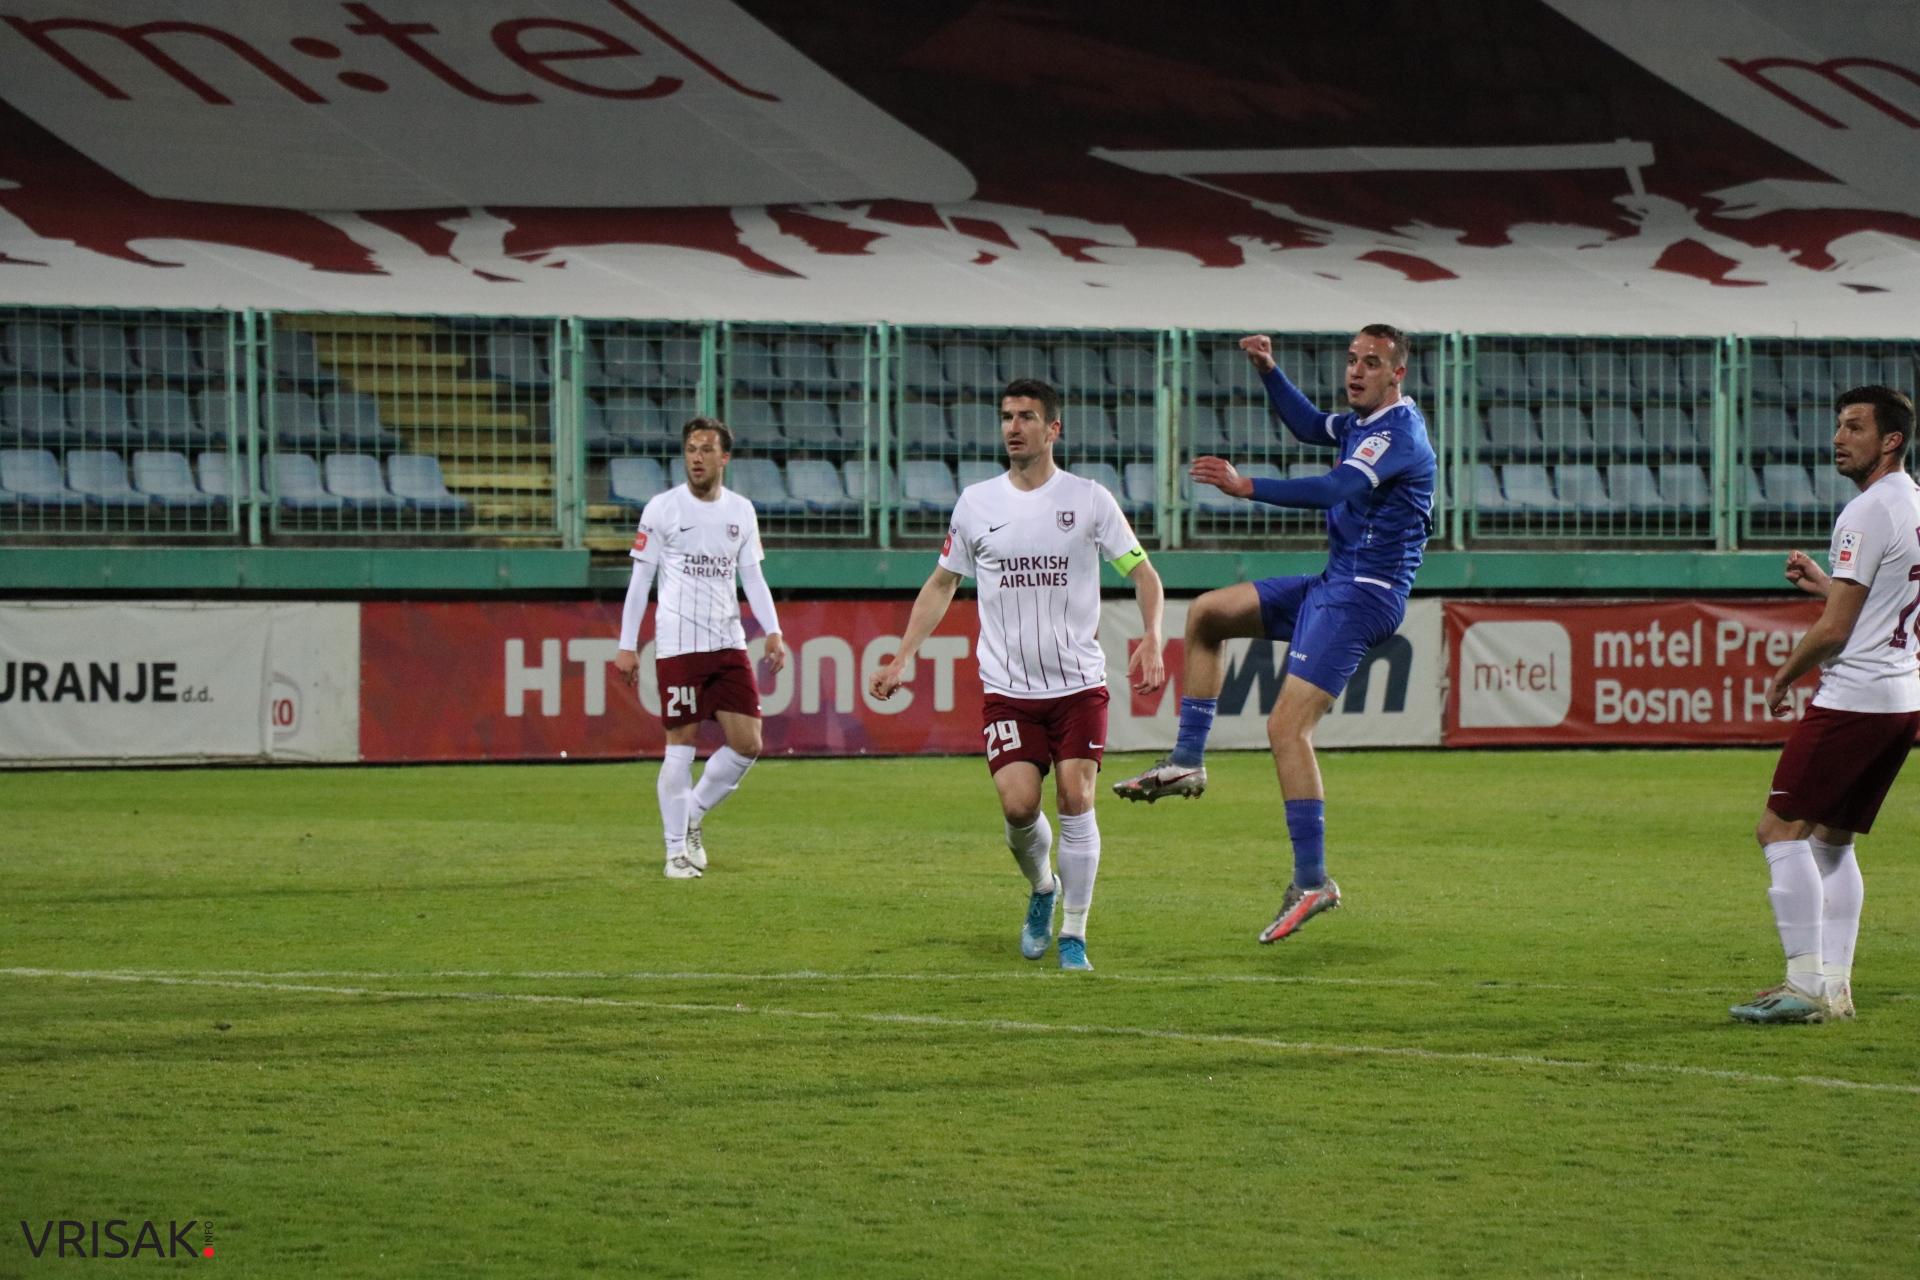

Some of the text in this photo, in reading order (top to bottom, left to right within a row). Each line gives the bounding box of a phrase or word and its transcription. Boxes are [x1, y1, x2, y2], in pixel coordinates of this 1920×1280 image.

[0, 0, 783, 105] m:tel
[998, 555, 1069, 572] TURKISH
[1000, 572, 1068, 588] AIRLINES
[1594, 619, 1702, 668] m:tel
[1474, 653, 1557, 691] m:tel
[667, 686, 697, 717] 24
[1594, 678, 1713, 724] Bosne
[1723, 676, 1733, 722] i
[983, 720, 1022, 761] 29
